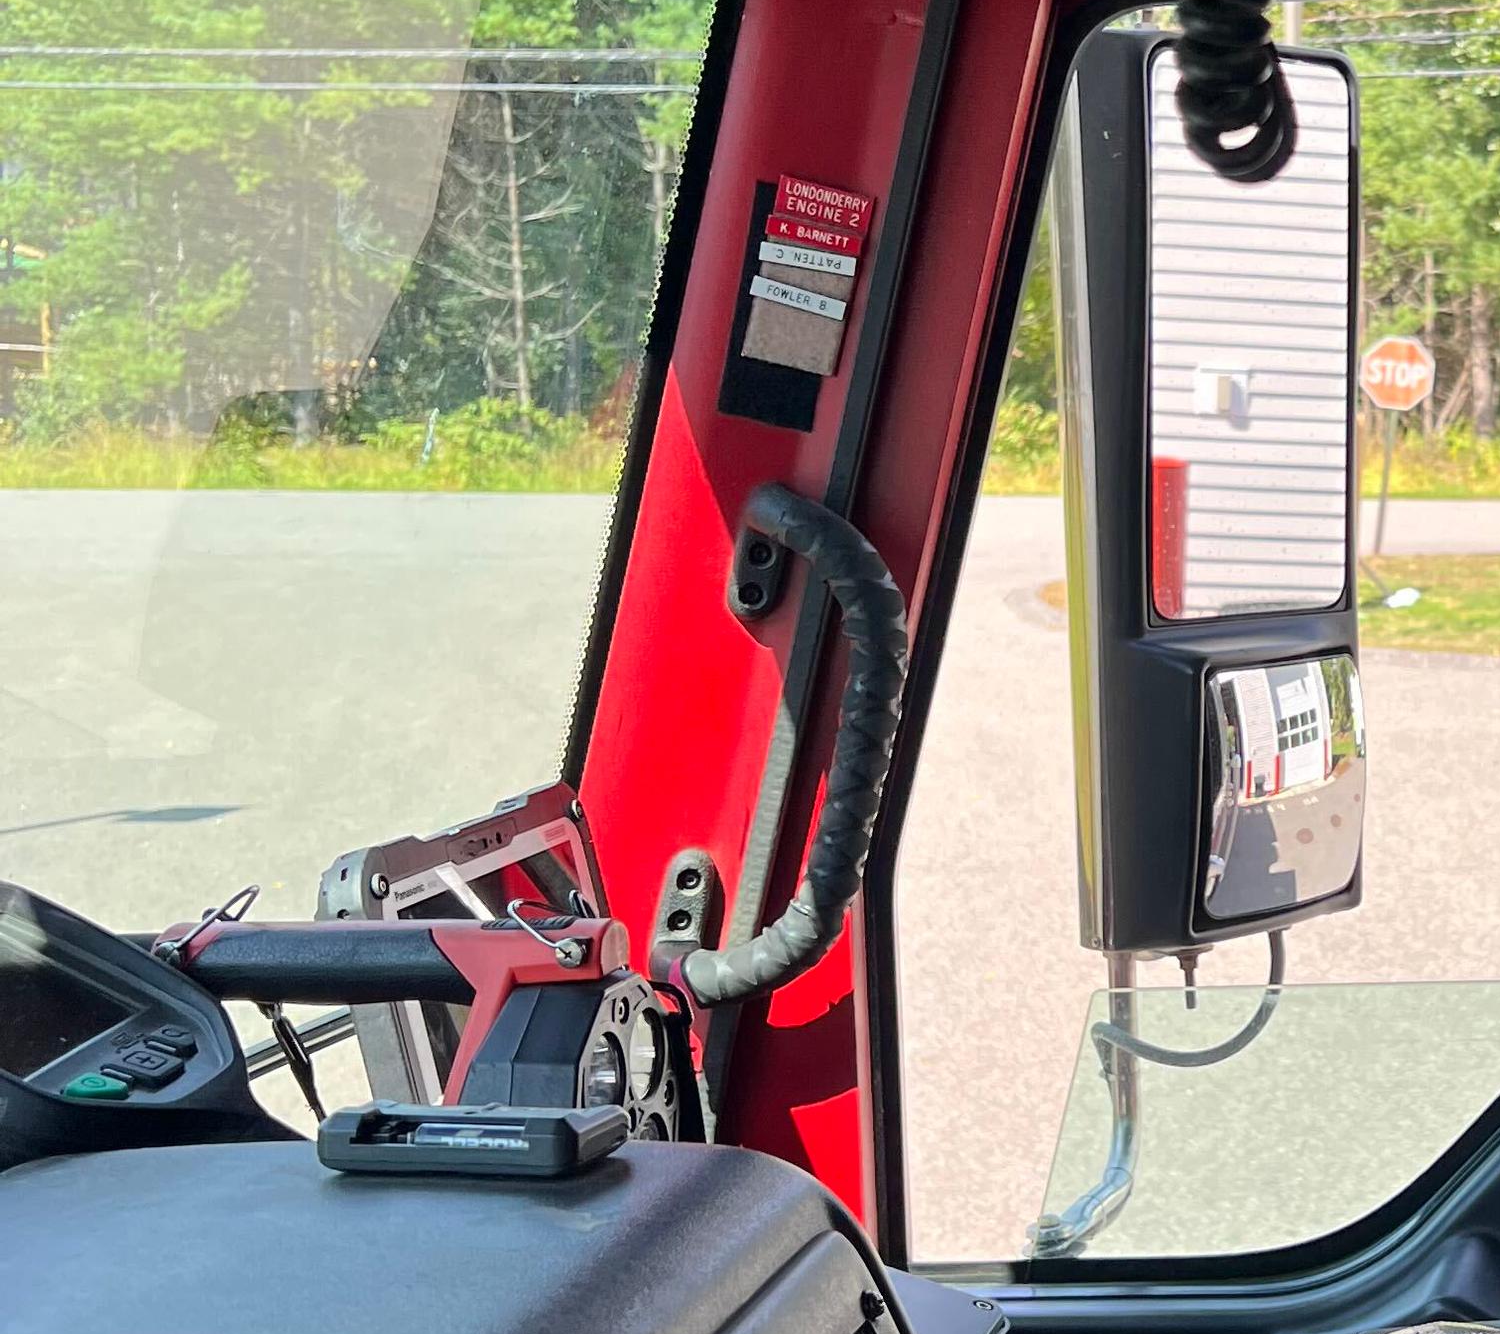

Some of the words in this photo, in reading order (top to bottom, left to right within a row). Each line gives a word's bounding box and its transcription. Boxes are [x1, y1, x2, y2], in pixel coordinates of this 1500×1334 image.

[785, 180, 869, 213] LONDONDERRY
[786, 196, 844, 223] ENGINE
[849, 212, 861, 227] 2
[780, 222, 791, 235] K.
[797, 226, 850, 249] BARNETT
[776, 248, 785, 259] C
[794, 251, 842, 270] PATTEN
[767, 284, 811, 306] FOWLER
[819, 300, 828, 311] B
[1367, 359, 1427, 389] STOP
